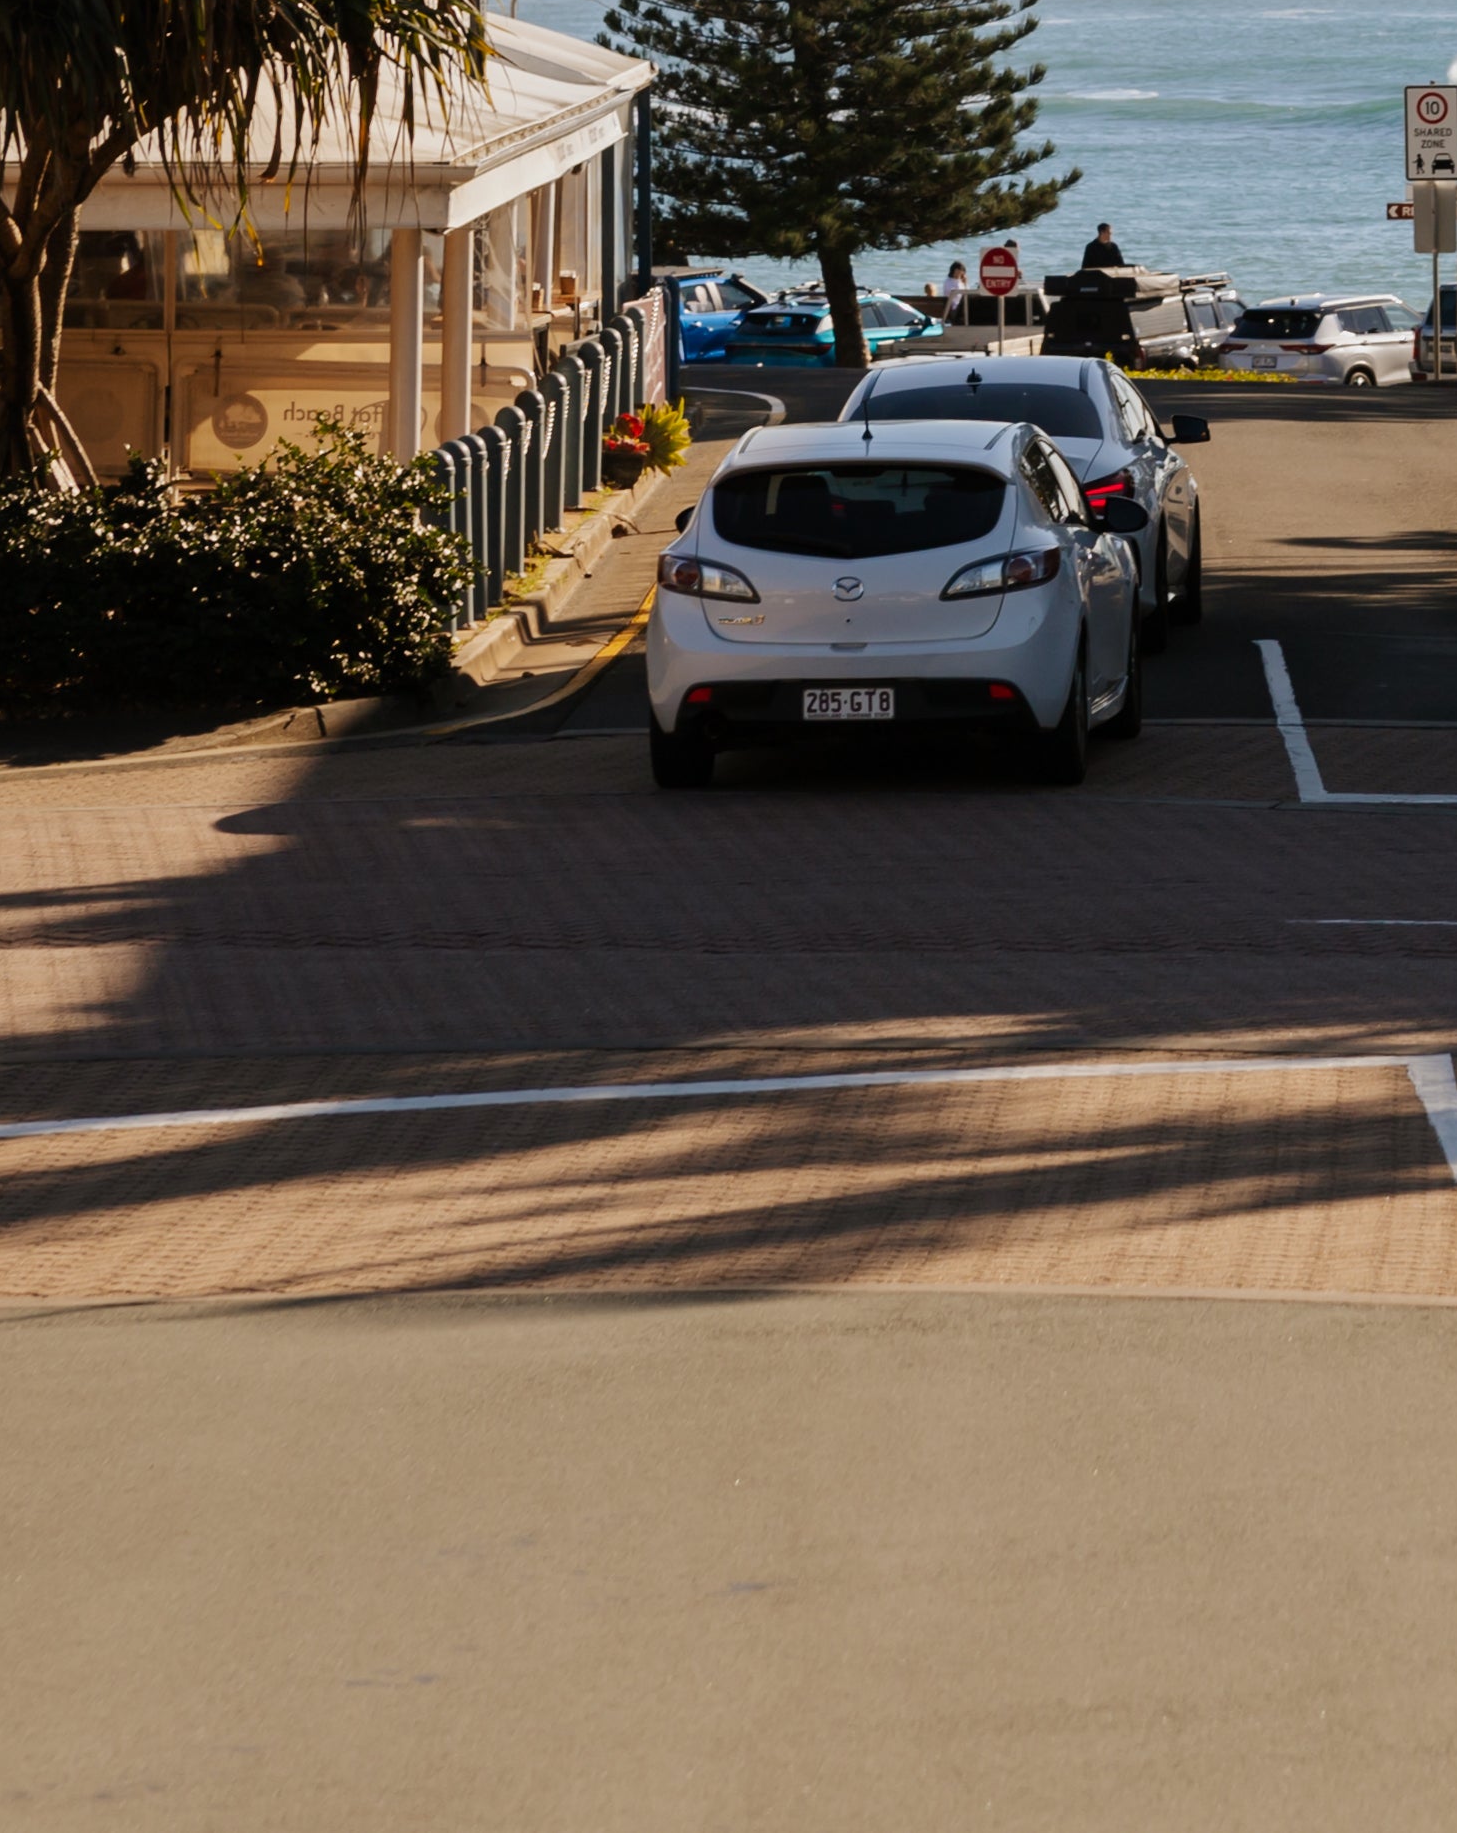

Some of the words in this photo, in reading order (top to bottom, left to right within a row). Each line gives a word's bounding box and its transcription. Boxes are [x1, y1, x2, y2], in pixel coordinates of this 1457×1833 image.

[1425, 101, 1440, 115] 10
[1413, 127, 1453, 137] SHARED
[1420, 139, 1446, 149] ZONE
[992, 255, 1005, 264] NO
[985, 279, 1012, 289] ENTRY
